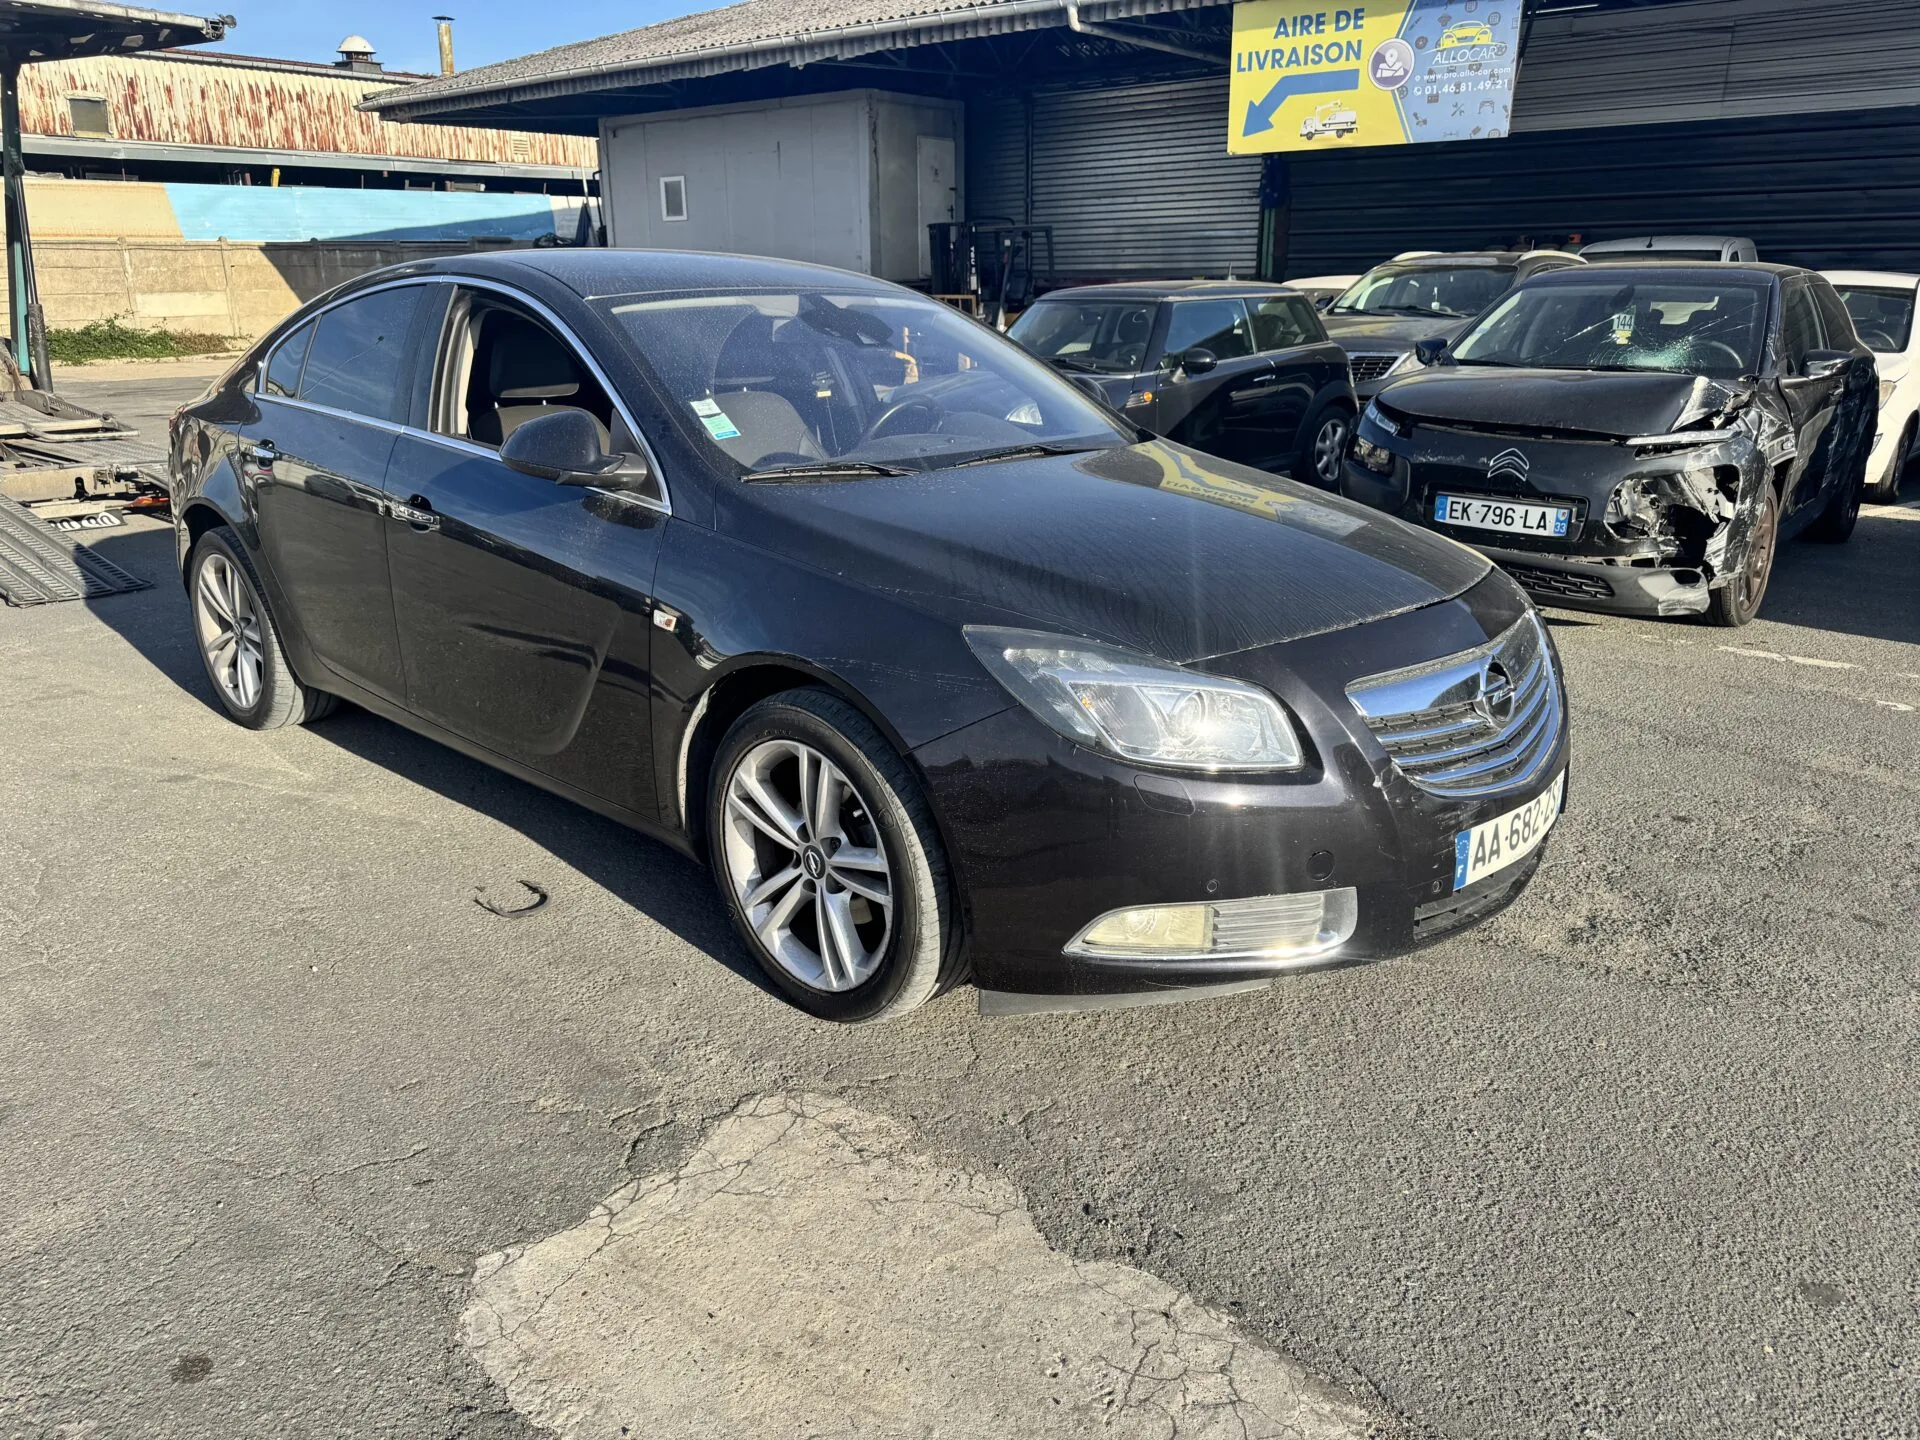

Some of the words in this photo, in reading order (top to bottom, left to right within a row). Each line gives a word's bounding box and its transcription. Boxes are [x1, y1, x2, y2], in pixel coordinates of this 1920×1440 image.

[1273, 15, 1325, 39] AIRE
[1334, 8, 1364, 30] DE
[1236, 40, 1362, 72] LIVRAISON
[1432, 46, 1497, 65] ALLOCAR
[1424, 79, 1508, 95] 01.46.81.49.21
[1554, 522, 1566, 534] 33
[1457, 865, 1464, 878] F
